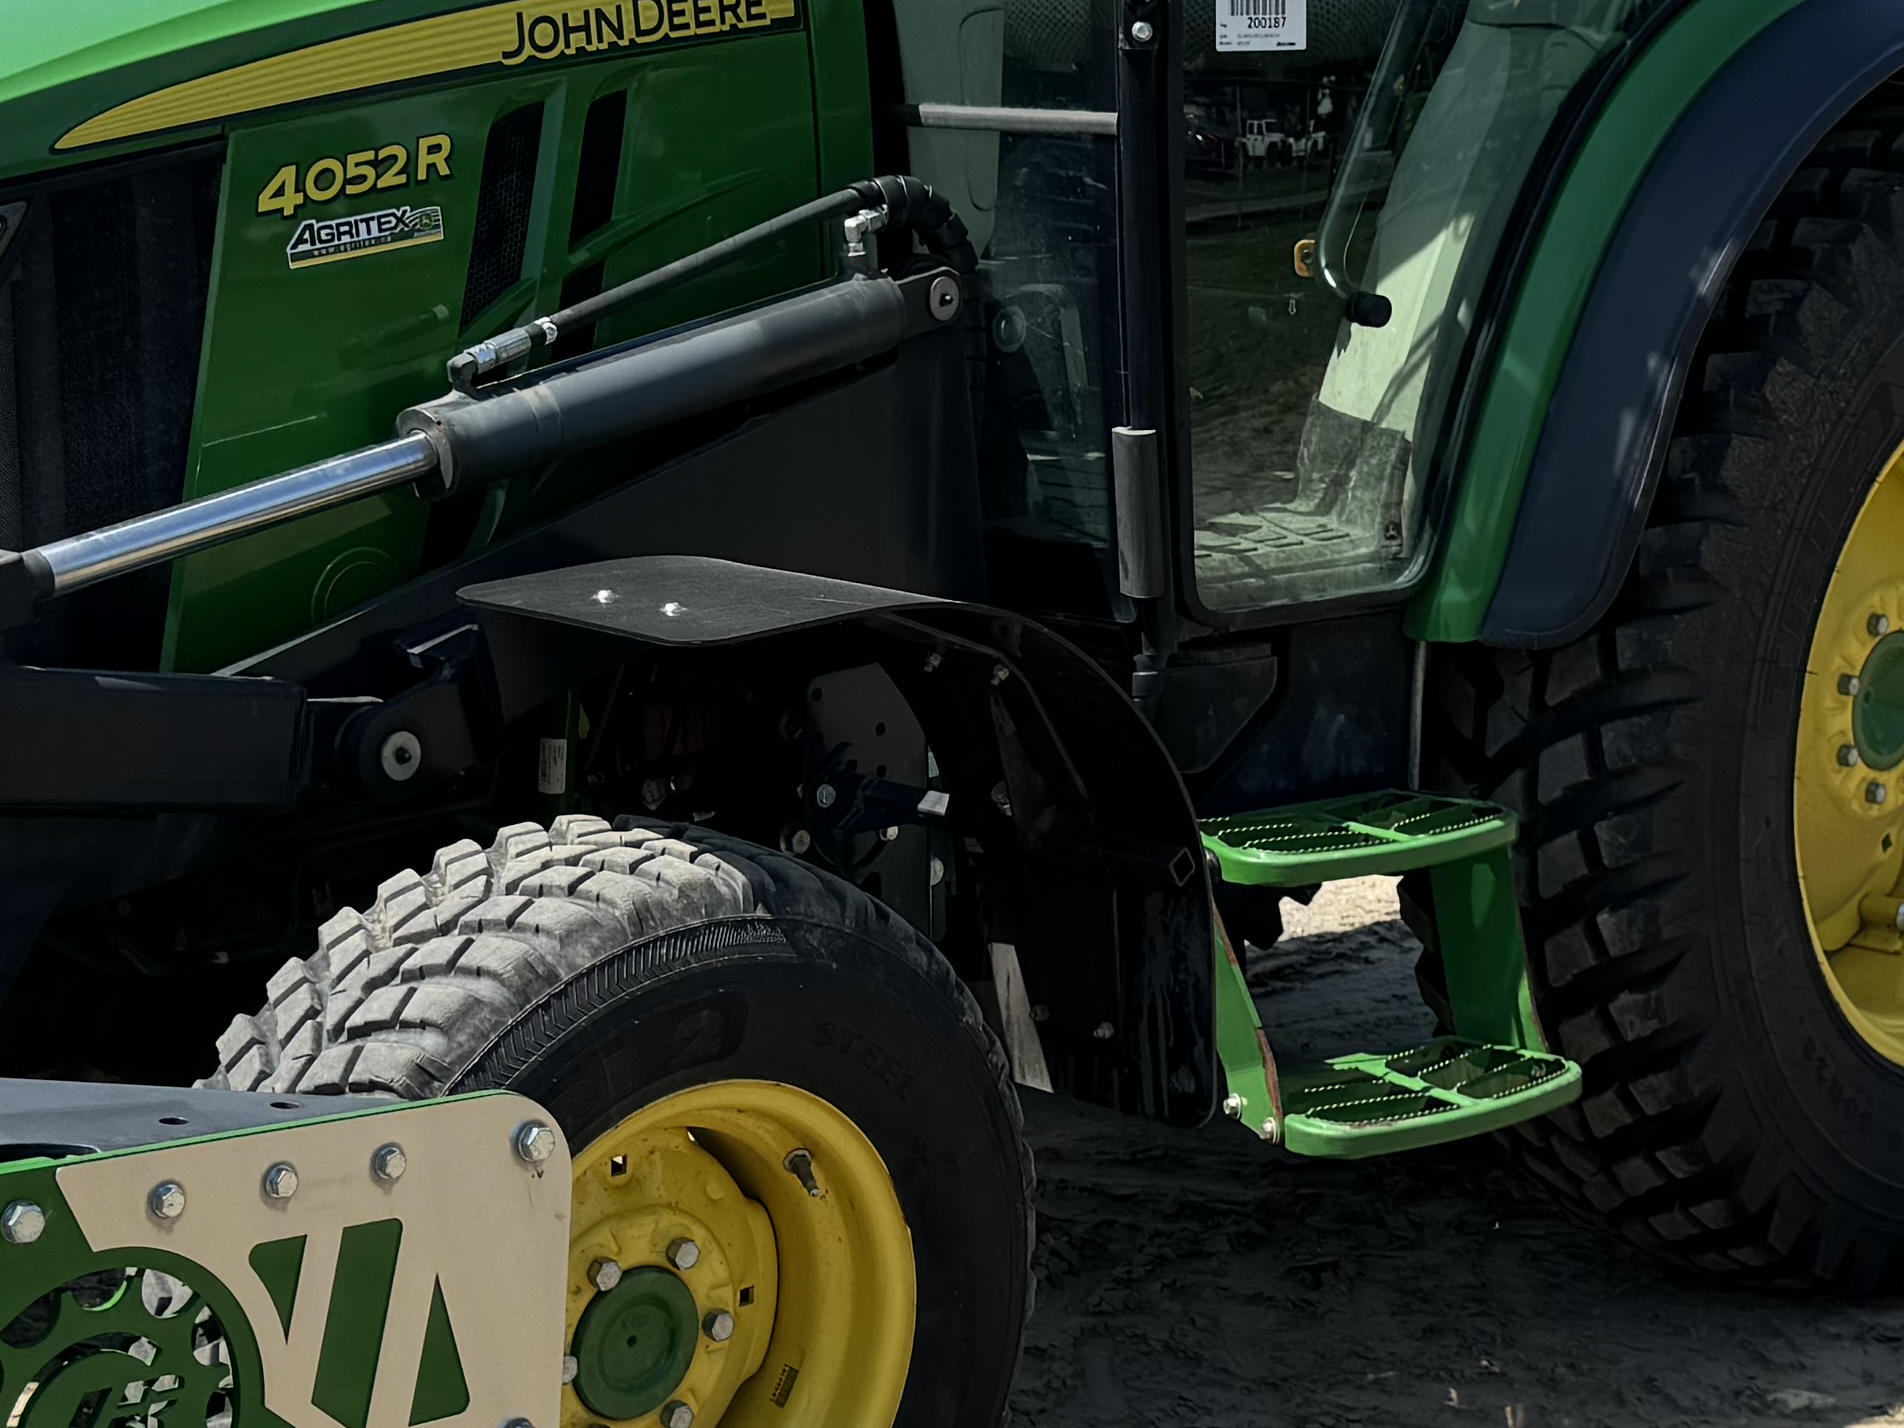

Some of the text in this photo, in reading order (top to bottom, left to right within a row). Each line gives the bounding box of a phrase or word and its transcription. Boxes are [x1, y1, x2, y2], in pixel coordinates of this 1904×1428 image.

[501, 3, 625, 60] JOHN
[1247, 17, 1287, 29] 200187
[289, 209, 411, 251] AGRITEX
[809, 1021, 914, 1104] STEEL
